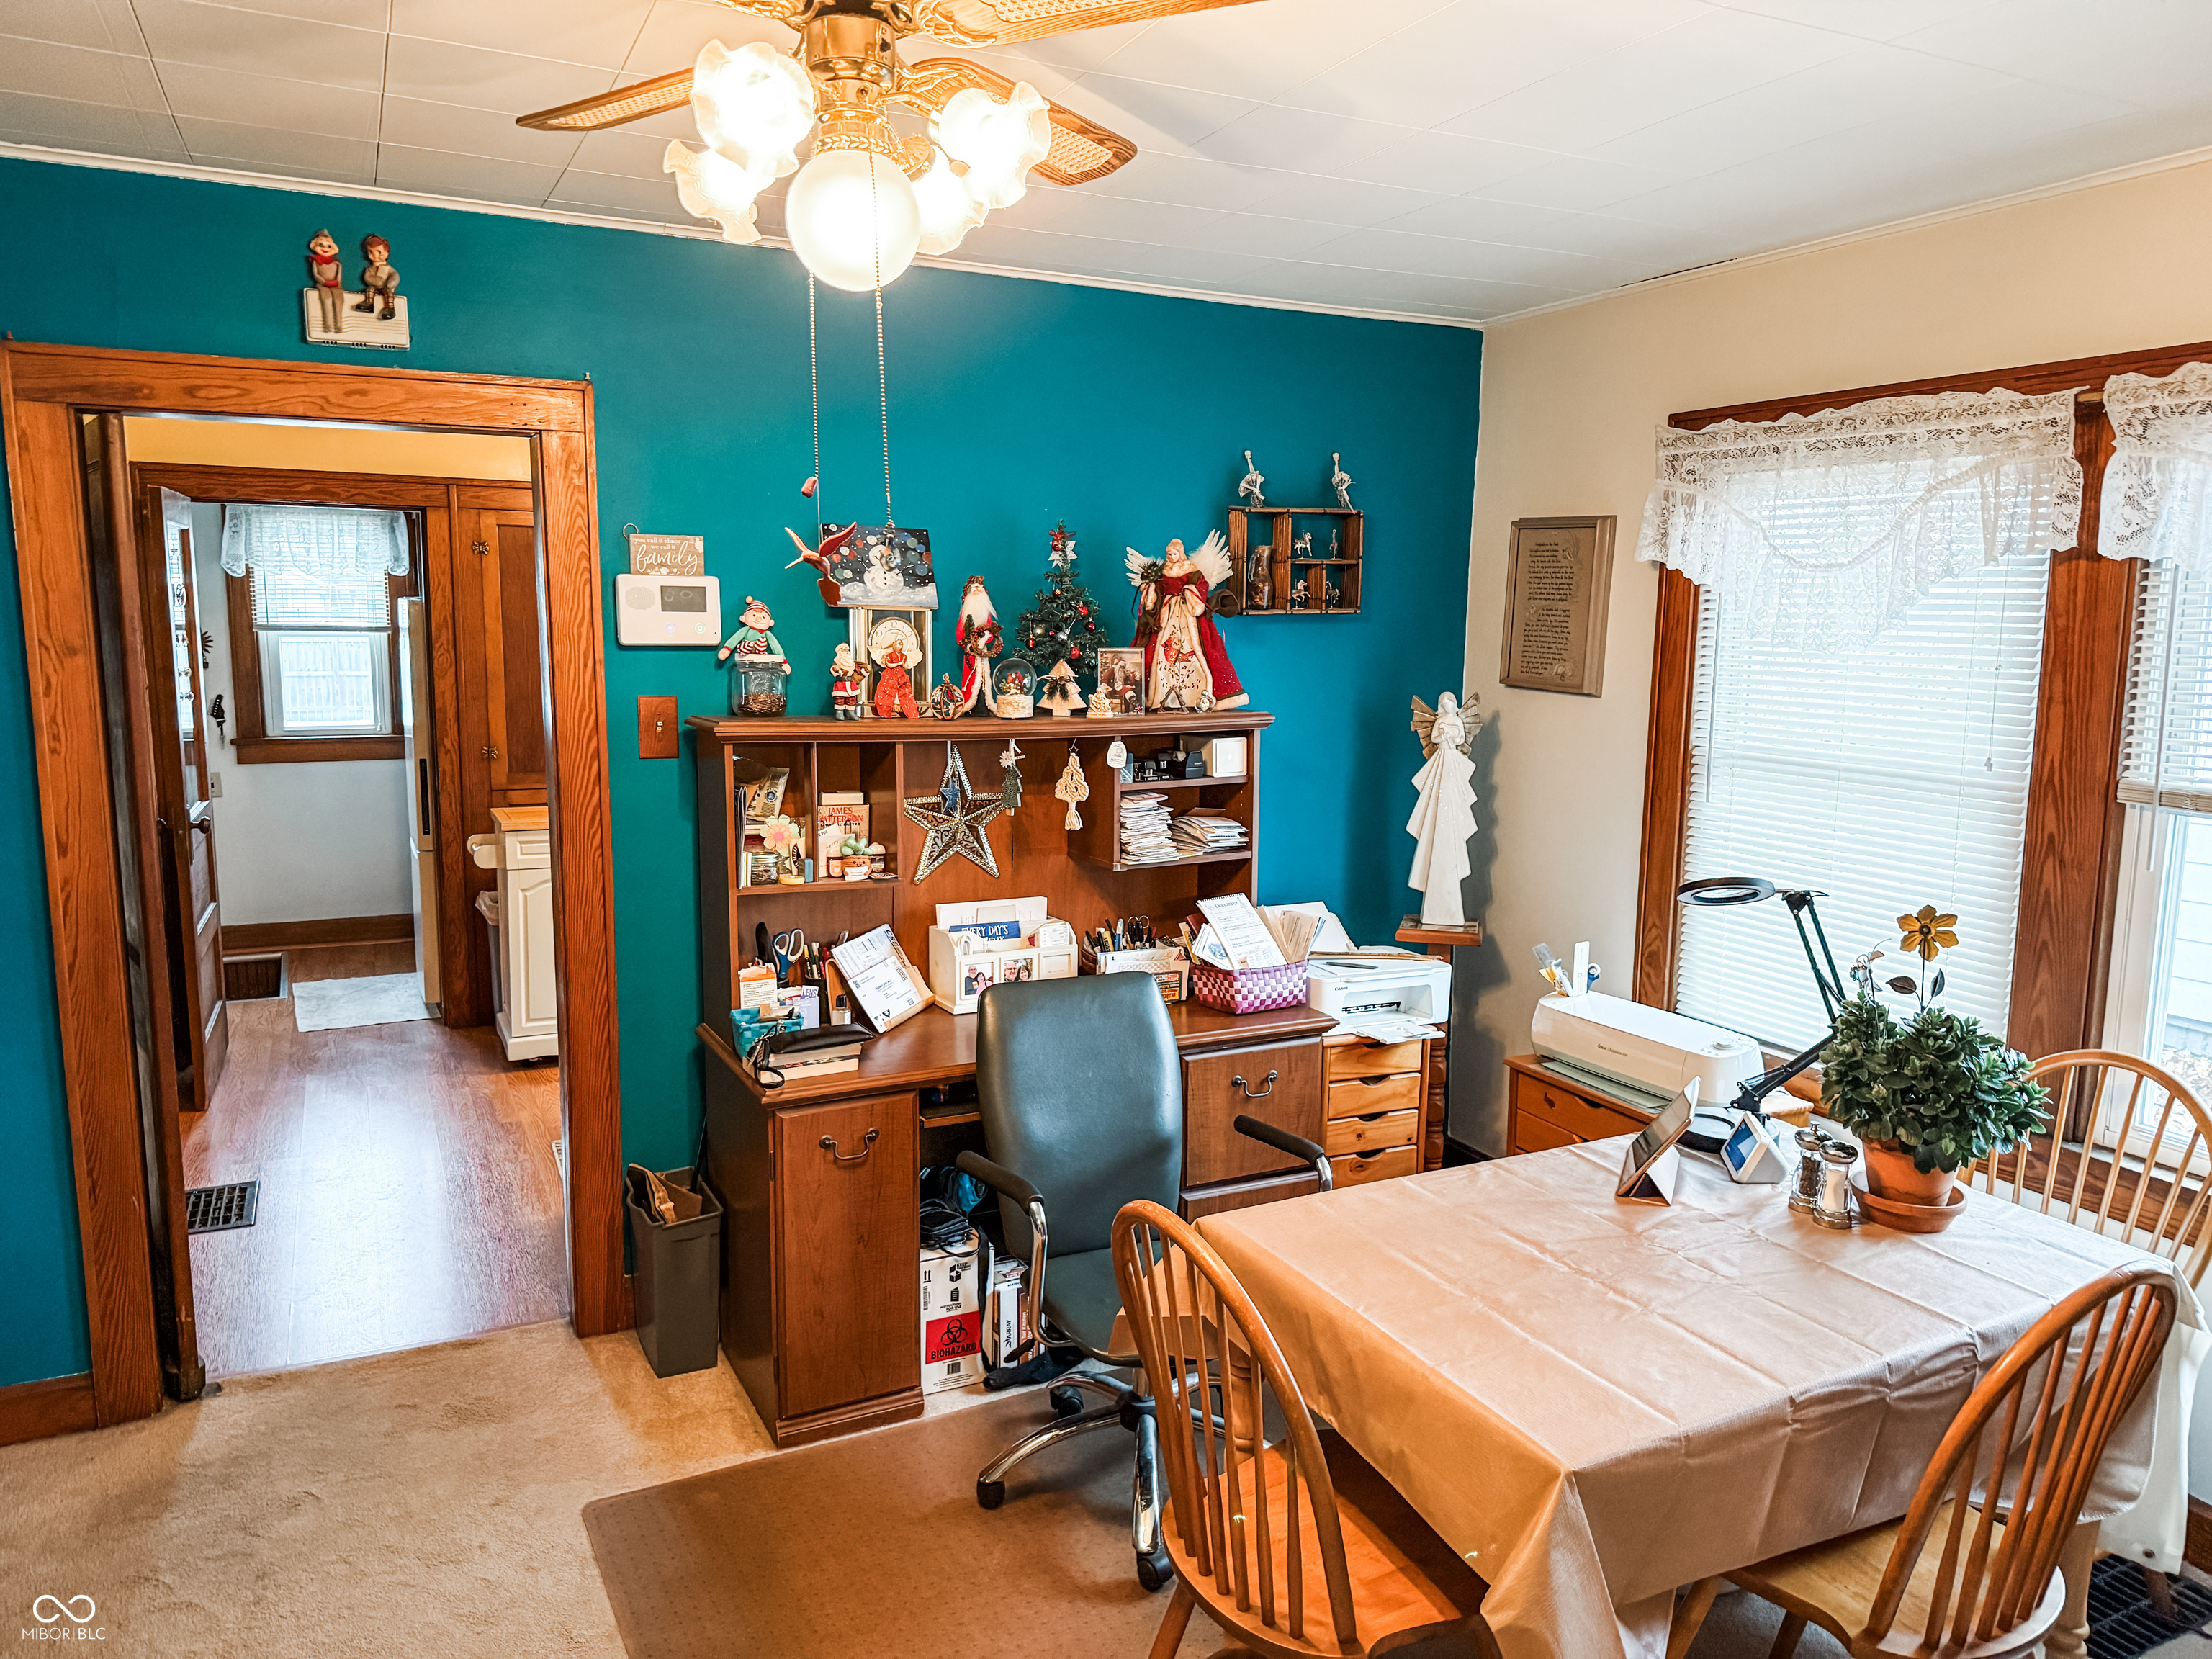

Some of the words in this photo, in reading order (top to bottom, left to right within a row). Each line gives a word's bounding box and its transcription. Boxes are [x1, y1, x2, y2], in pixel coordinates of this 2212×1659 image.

[637, 541, 702, 576] family
[828, 806, 853, 815] JAMES
[819, 814, 863, 823] PATTERSON
[989, 925, 1009, 936] DAY'S
[802, 988, 817, 998] LENS
[931, 1342, 977, 1360] BIOHAZARD
